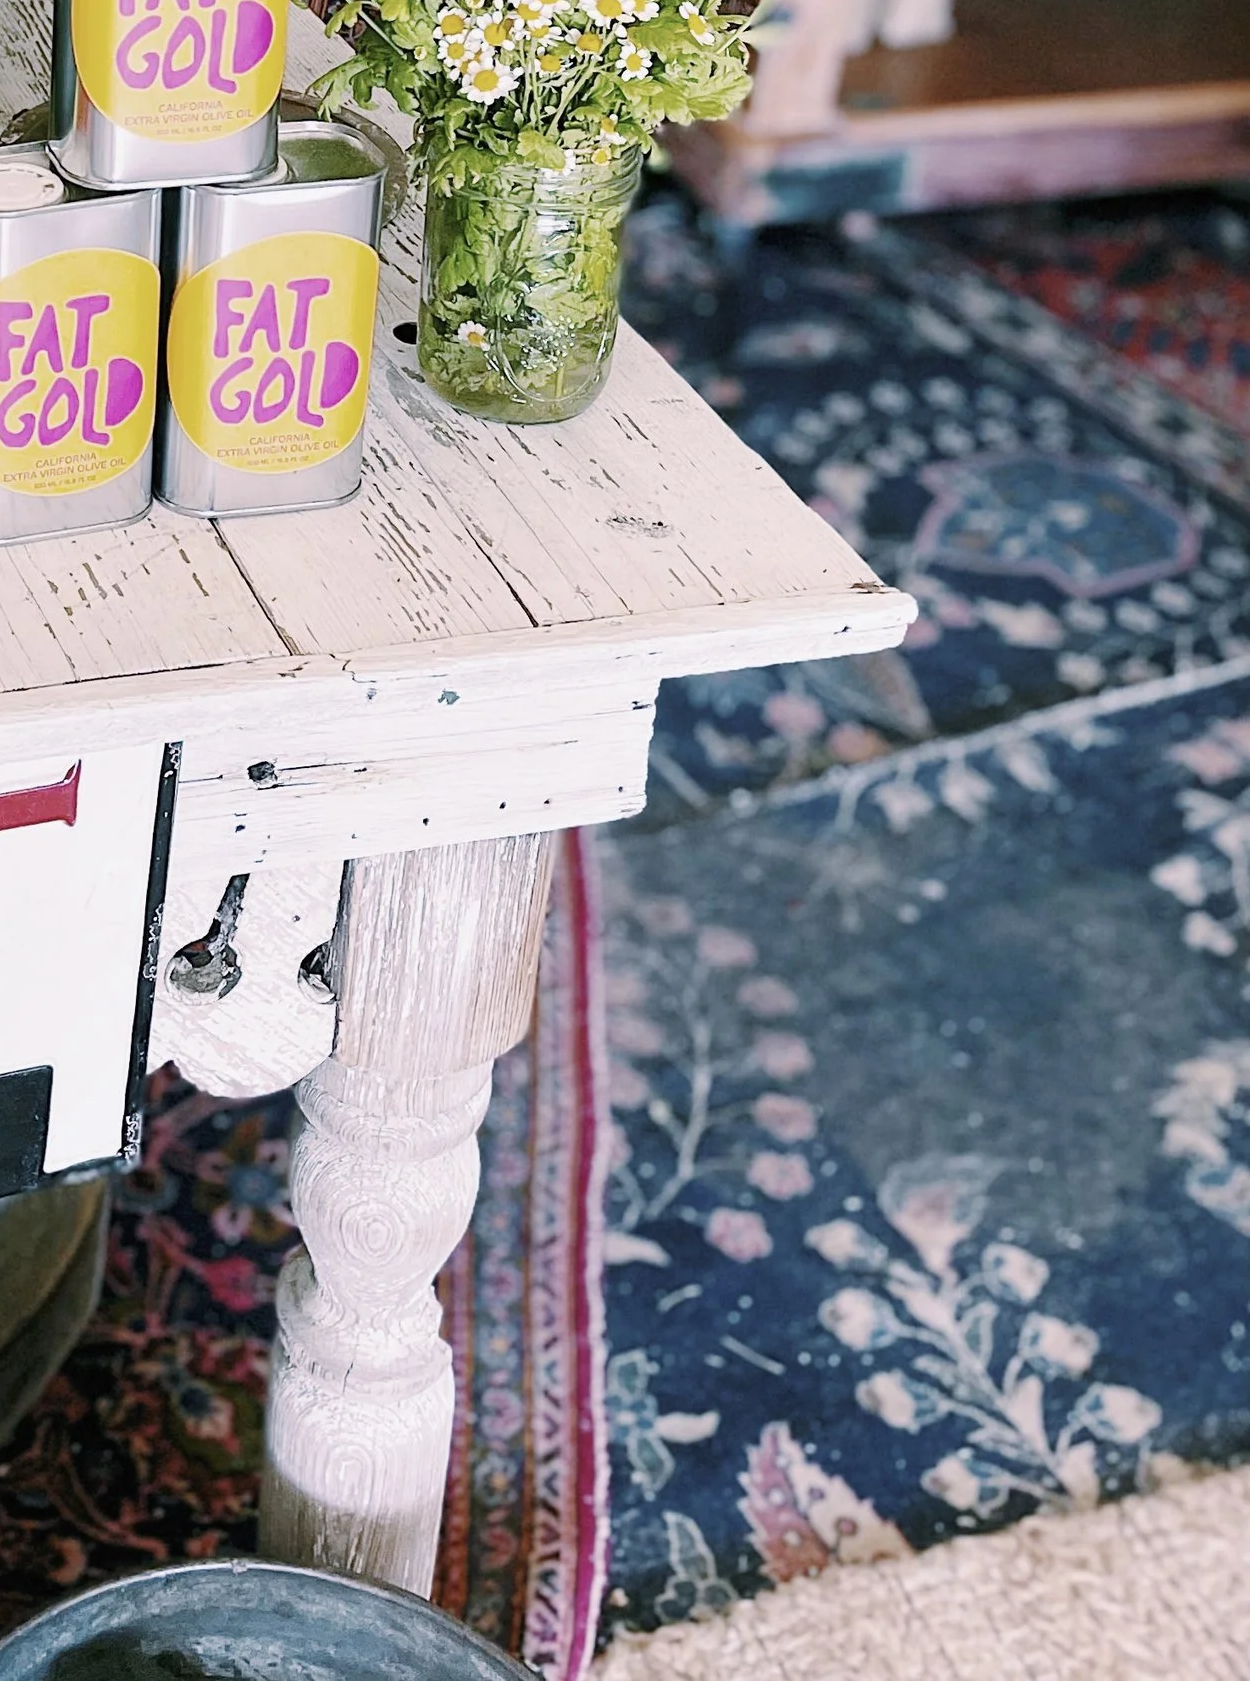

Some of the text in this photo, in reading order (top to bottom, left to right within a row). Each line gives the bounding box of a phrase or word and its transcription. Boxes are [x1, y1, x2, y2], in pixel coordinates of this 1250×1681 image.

[116, 0, 273, 94] GOLD
[158, 100, 223, 113] CALIFORNIA
[124, 108, 254, 126] EXTRA VIRGIN OLIVE OIL
[213, 278, 330, 358] FAT
[210, 341, 359, 429] GOLD
[249, 433, 310, 446] CALIFORNIA
[216, 440, 339, 458] EXTRA VIRGIN OLIVE OIL
[35, 452, 97, 469] CALIFORNIA
[3, 457, 126, 483] EXTRA VIRGIN OLIVE OIL
